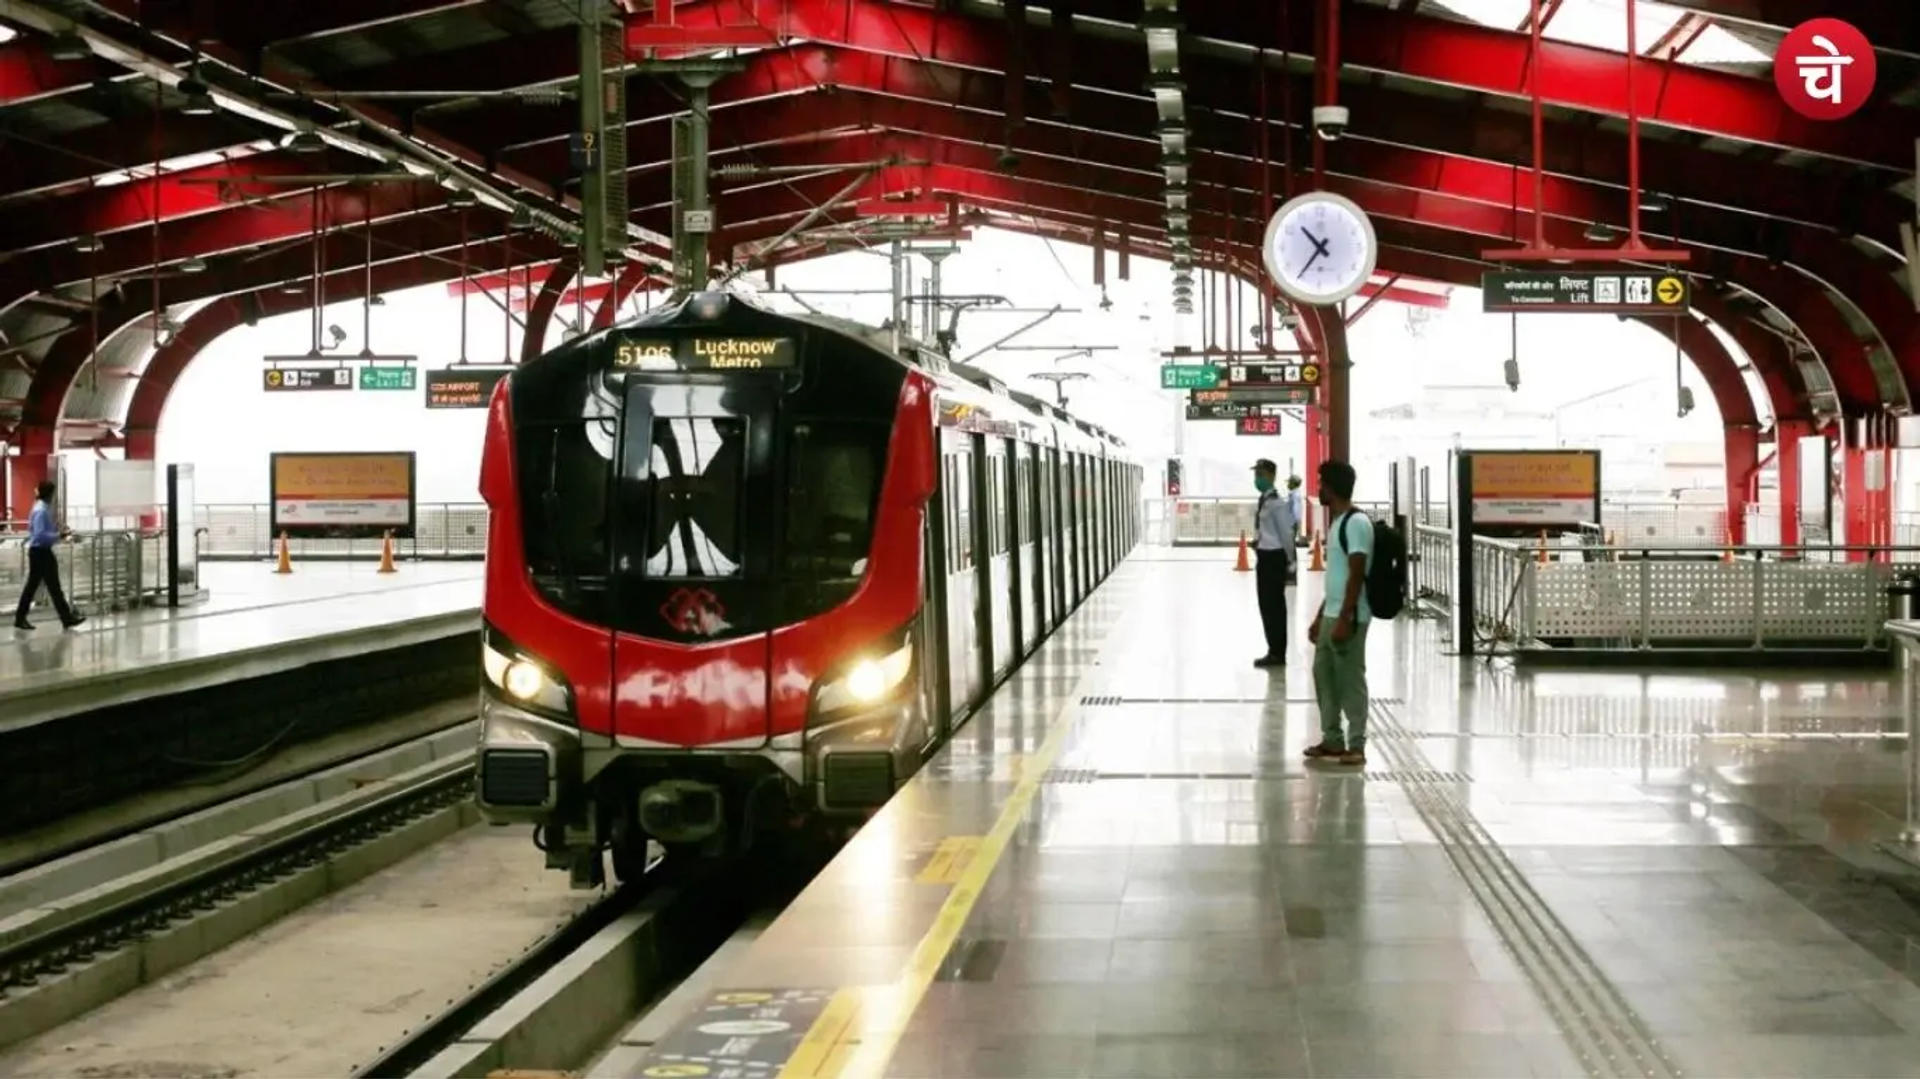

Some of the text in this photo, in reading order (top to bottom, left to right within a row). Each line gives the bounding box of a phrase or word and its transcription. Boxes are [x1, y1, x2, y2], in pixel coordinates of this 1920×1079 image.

[583, 132, 594, 149] 9
[1570, 292, 1590, 303] Lift
[695, 338, 777, 355] Lucknow
